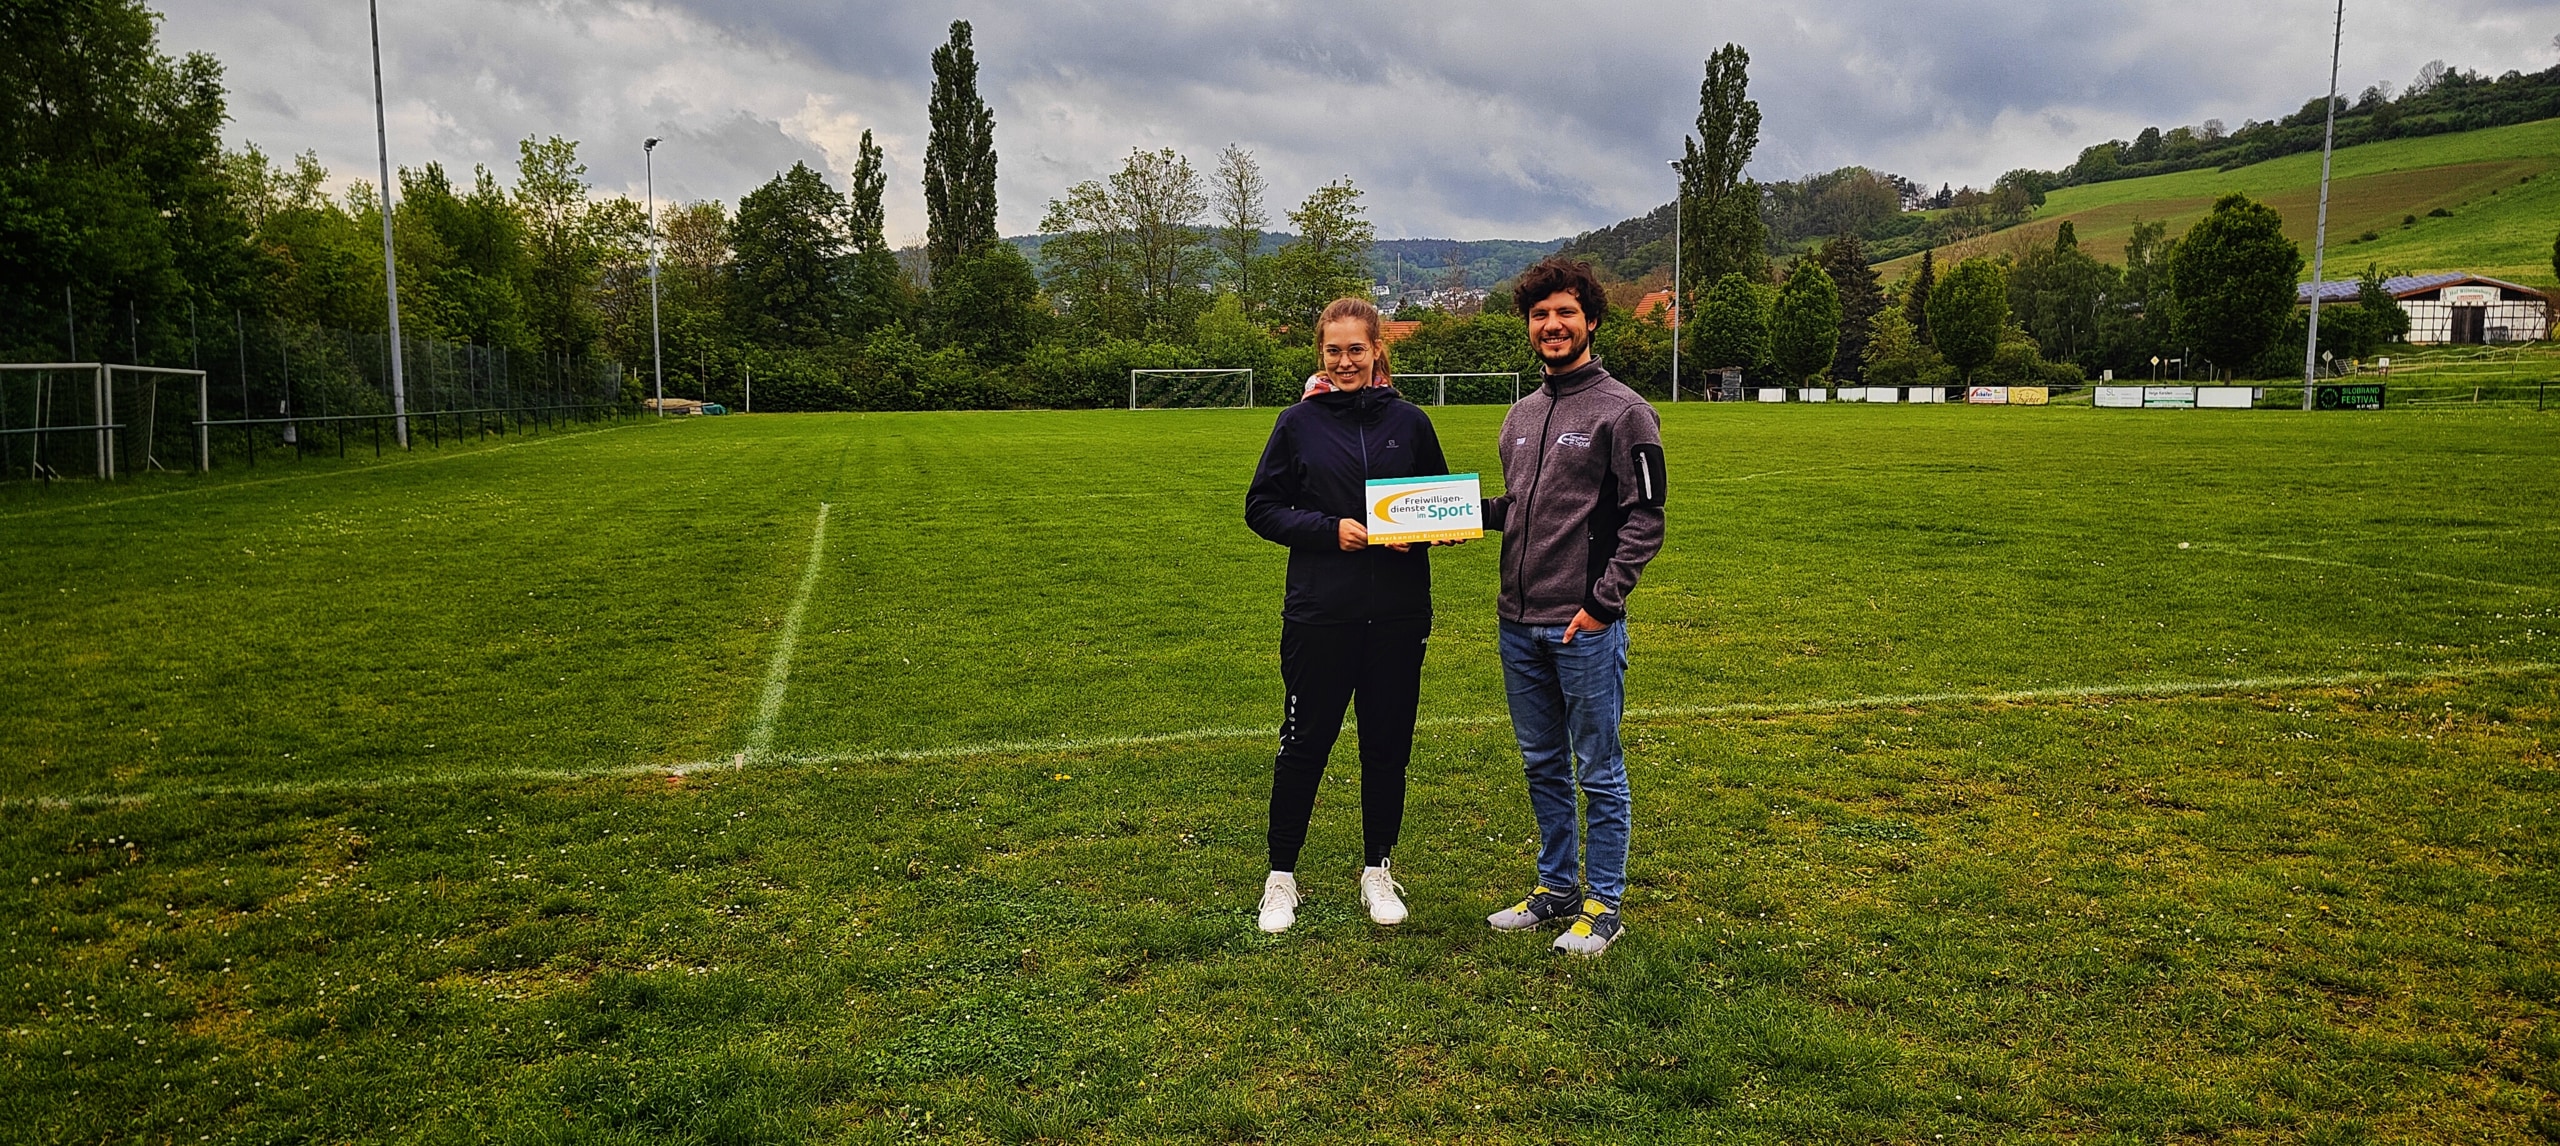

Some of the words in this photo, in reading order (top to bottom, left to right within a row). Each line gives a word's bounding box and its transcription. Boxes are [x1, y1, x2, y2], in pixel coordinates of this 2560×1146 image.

[2342, 387, 2380, 395] SILOBRAND
[2341, 395, 2380, 404] FESTIVAL
[1405, 495, 1463, 505] Freiwilligen-
[1390, 504, 1425, 513] dienste
[1428, 503, 1473, 520] Sport
